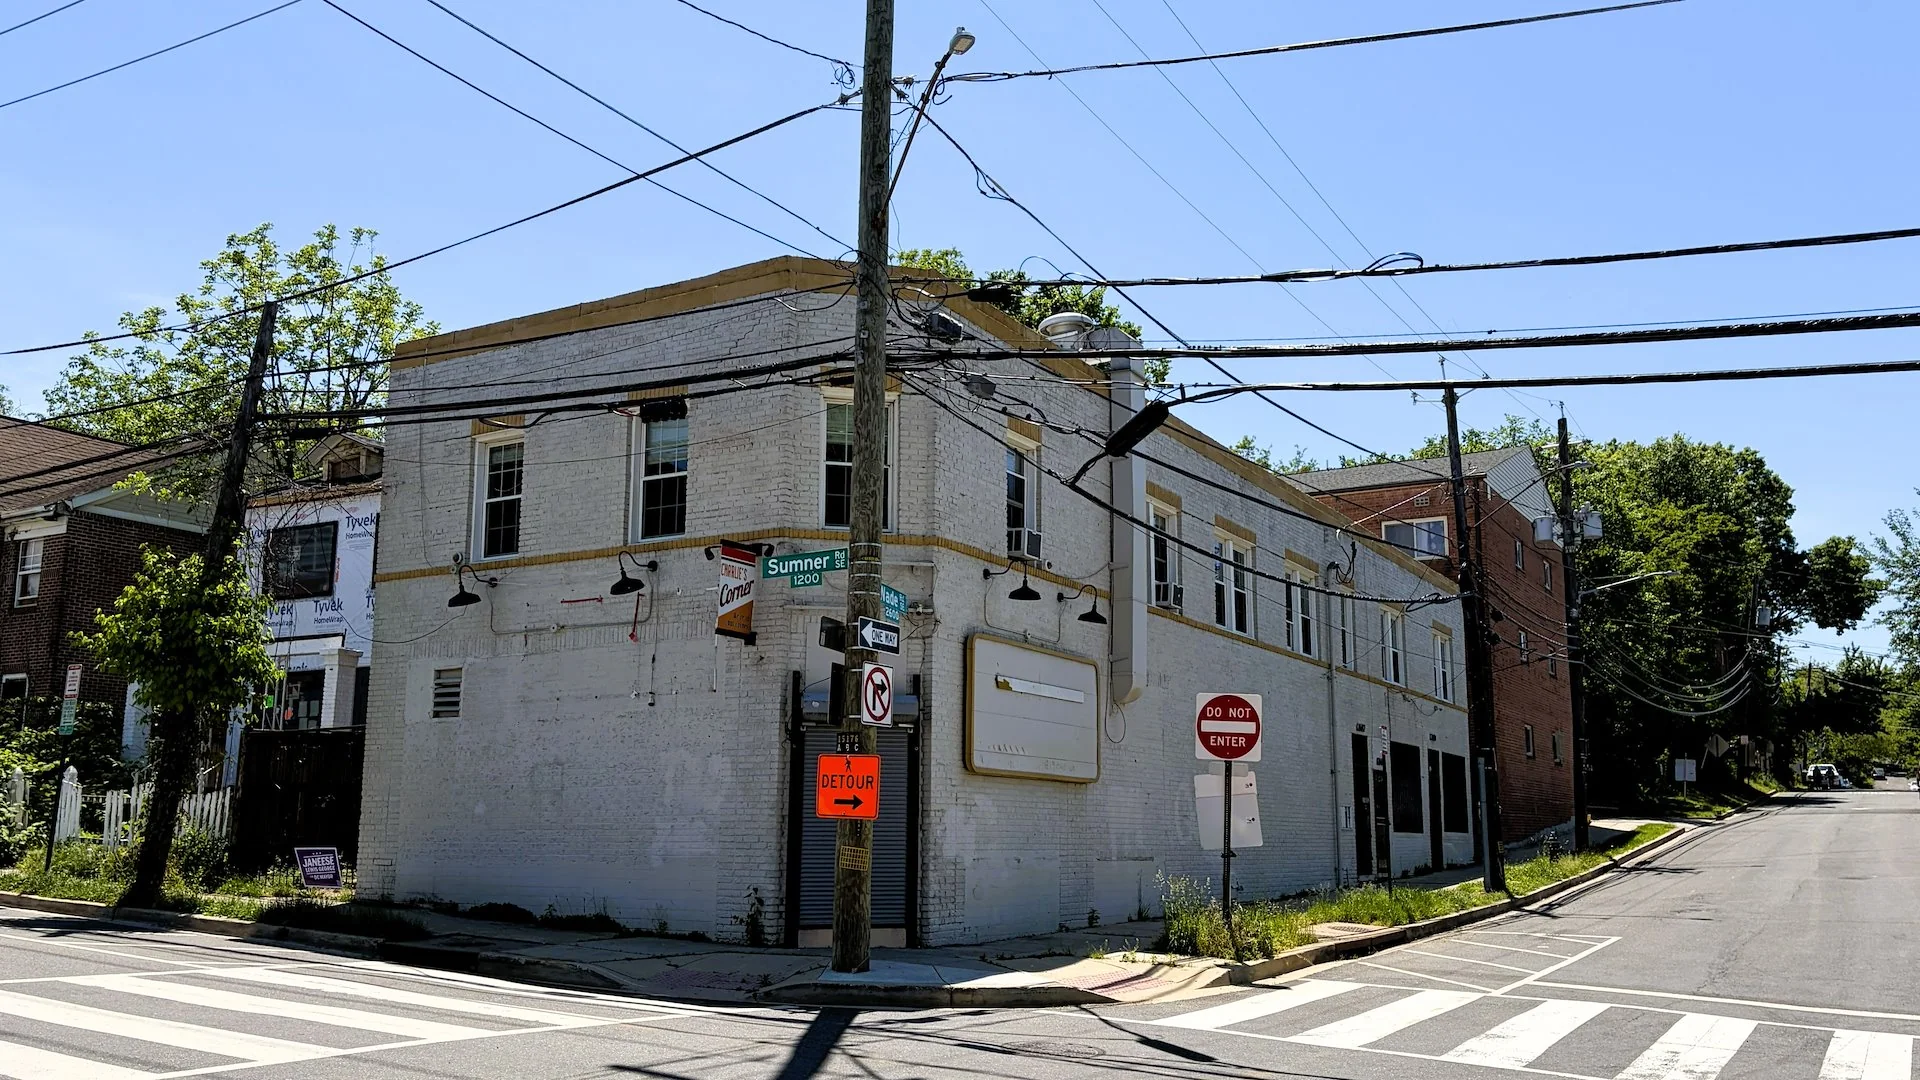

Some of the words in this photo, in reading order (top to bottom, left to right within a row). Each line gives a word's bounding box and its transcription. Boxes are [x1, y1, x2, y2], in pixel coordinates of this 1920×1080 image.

[345, 513, 376, 531] Tyvek
[834, 551, 845, 560] Rd
[721, 563, 748, 581] CHARLIE'S
[768, 556, 829, 574] Sumner
[835, 560, 846, 569] SE
[793, 573, 820, 586] 1200
[720, 580, 755, 608] Corner
[313, 597, 343, 617] Tyvek
[871, 629, 884, 643] ONE
[884, 631, 897, 645] WAY
[1206, 706, 1222, 718] DO
[1229, 707, 1251, 719] NOT
[1210, 735, 1246, 747] ENTER
[821, 774, 875, 790] DETOUR
[303, 857, 335, 867] JANEESE
